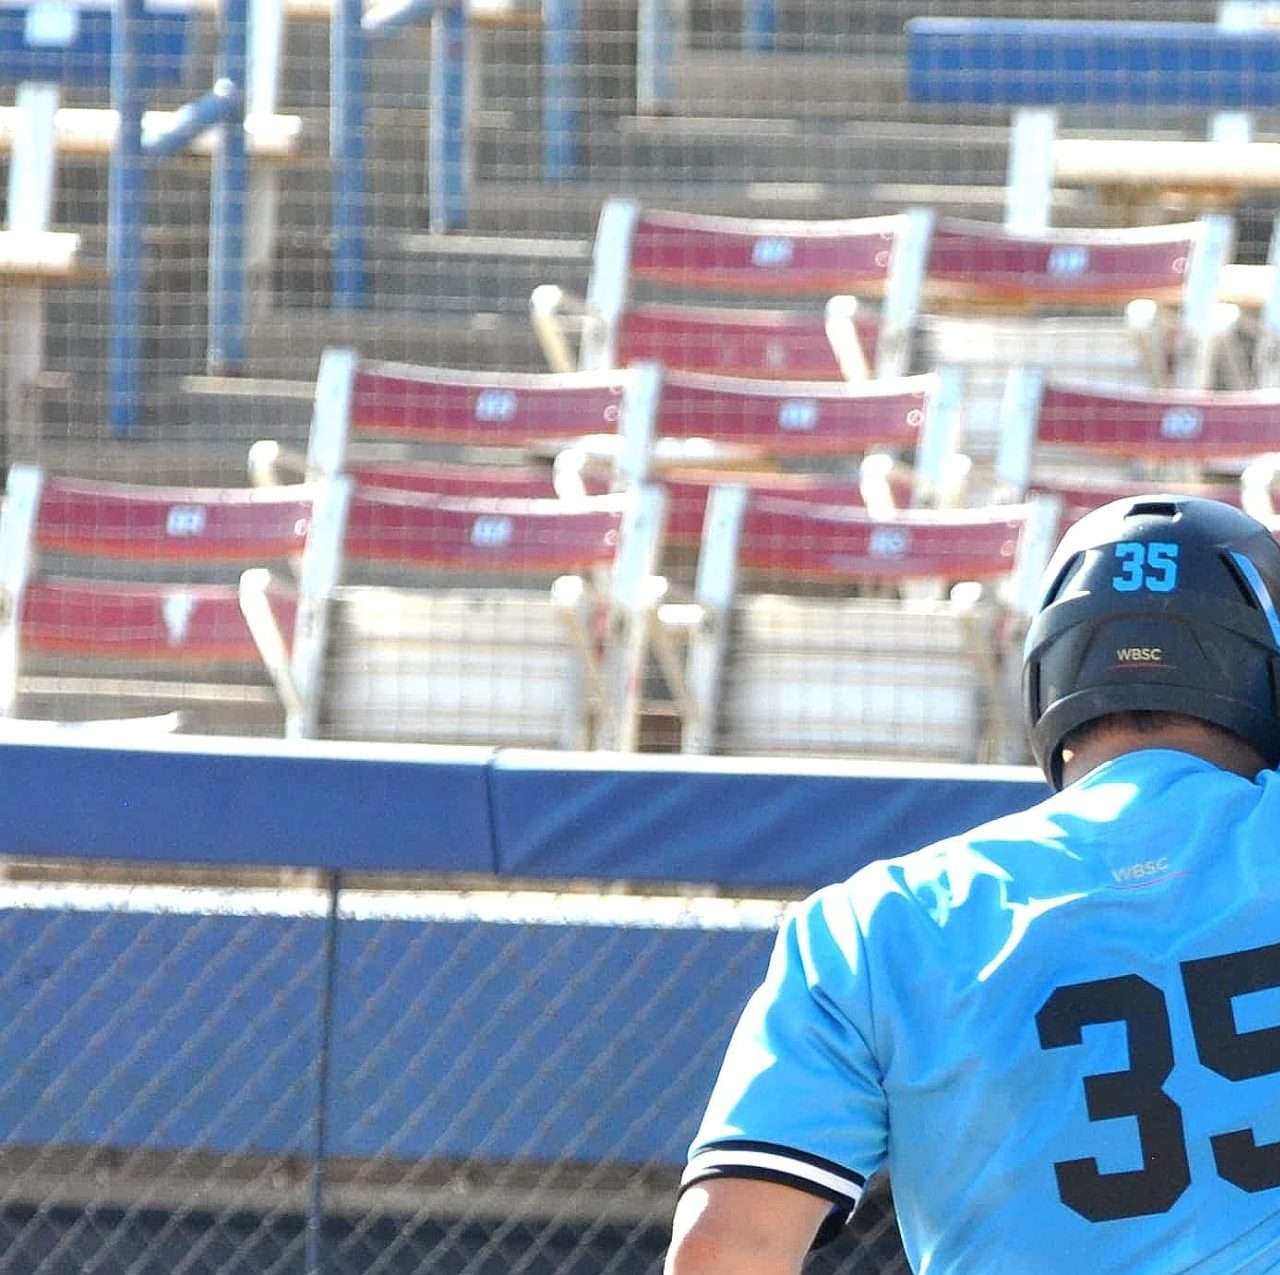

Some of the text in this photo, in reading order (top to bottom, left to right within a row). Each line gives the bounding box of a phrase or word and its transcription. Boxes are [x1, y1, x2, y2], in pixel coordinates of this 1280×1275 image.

[1112, 541, 1180, 592] 35
[1116, 647, 1163, 662] WBSC
[1111, 856, 1169, 883] WBSC
